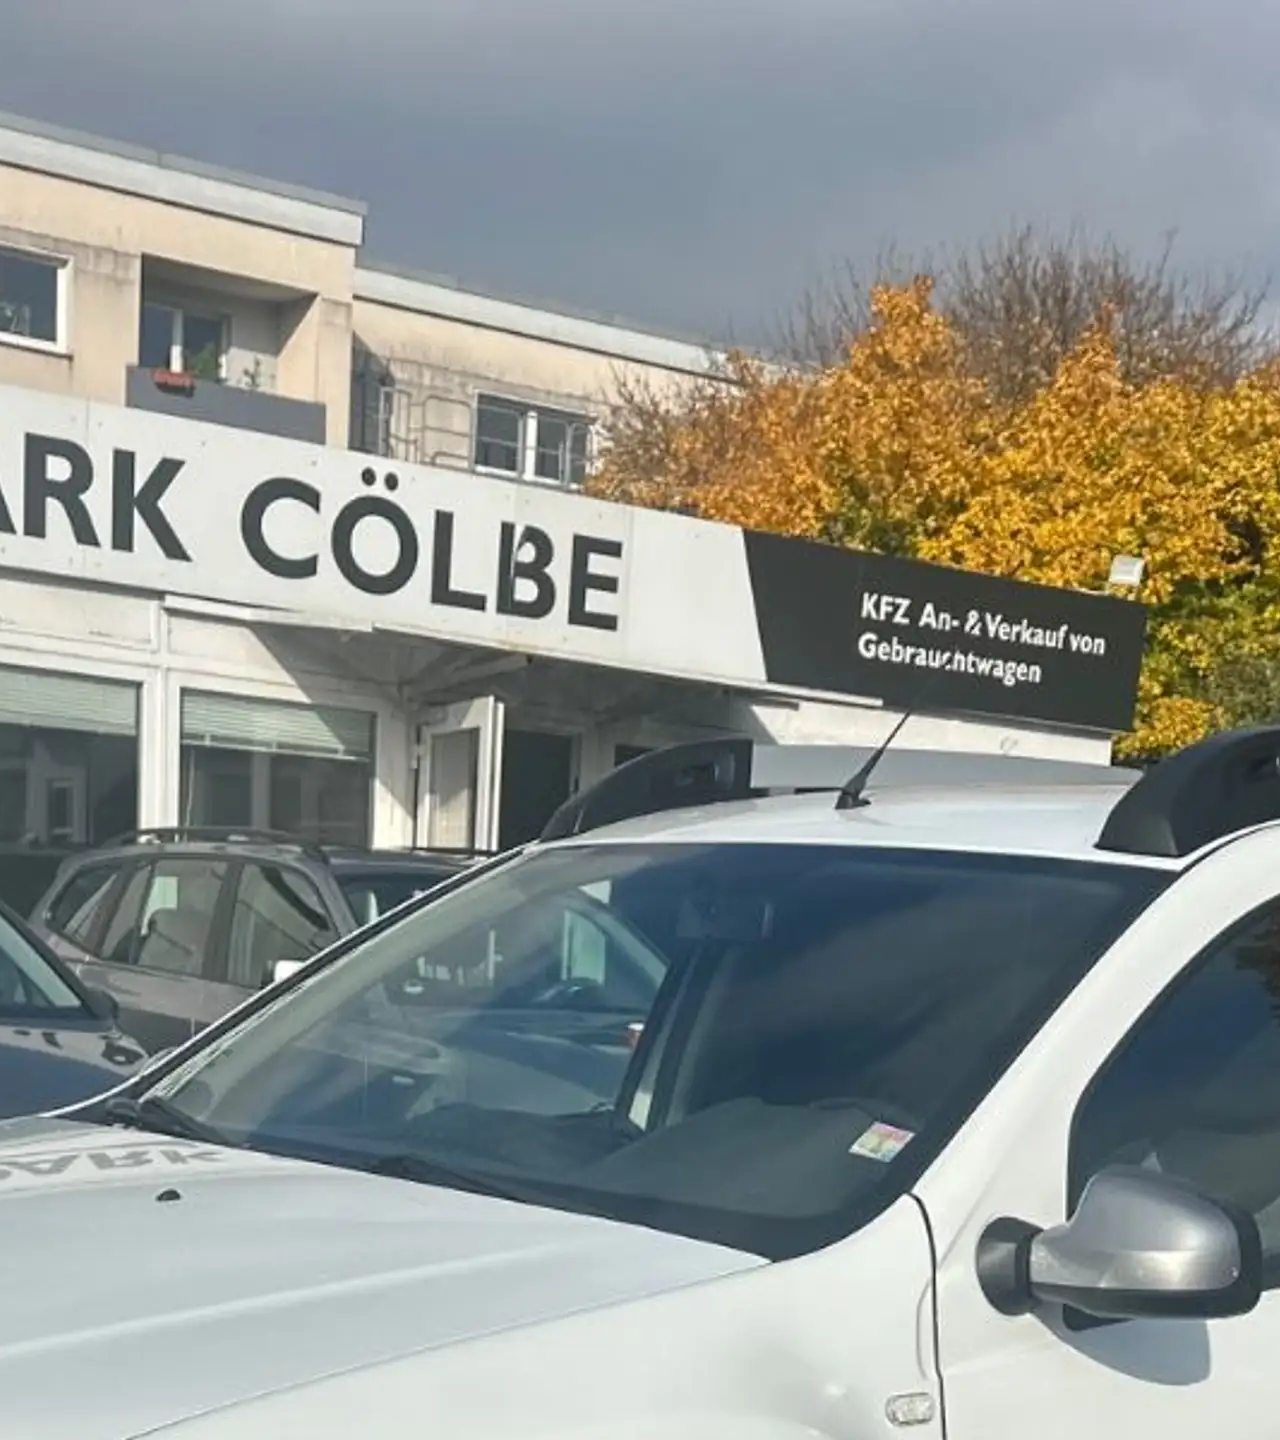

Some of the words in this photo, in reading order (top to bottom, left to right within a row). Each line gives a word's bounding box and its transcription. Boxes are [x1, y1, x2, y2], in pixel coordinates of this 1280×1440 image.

[239, 466, 625, 632] CÖLBE
[860, 591, 911, 626] KFZ
[919, 604, 960, 632] An-
[984, 611, 1069, 652] Verkauf
[1069, 633, 1106, 656] von
[857, 631, 1042, 685] Gebrauchtwagen
